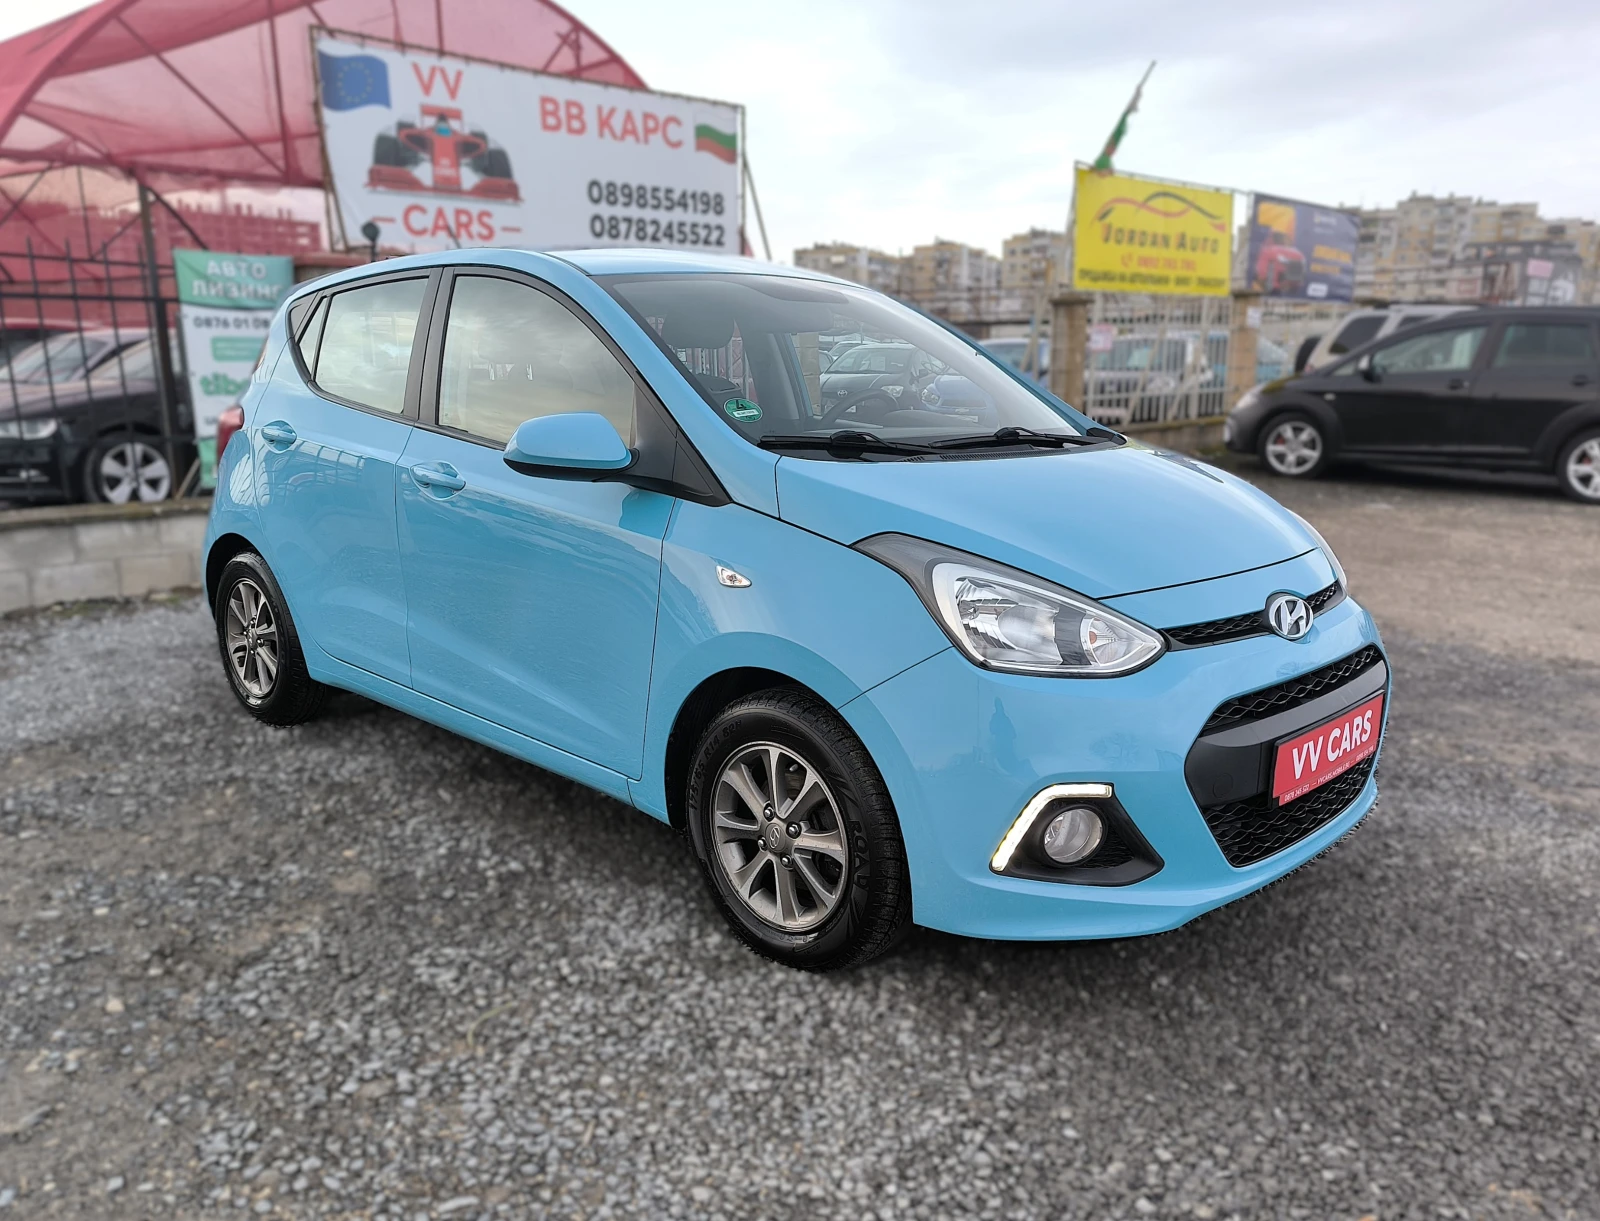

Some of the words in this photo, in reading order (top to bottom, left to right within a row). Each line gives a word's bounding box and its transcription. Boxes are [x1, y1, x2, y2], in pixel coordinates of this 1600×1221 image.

[411, 62, 464, 100] VV
[597, 105, 685, 149] КАРС
[587, 180, 726, 216] 0898554198
[403, 204, 496, 242] CARS
[590, 214, 726, 248] 0878245522
[206, 259, 267, 280] АВТО
[1292, 735, 1324, 780] VV
[1326, 709, 1373, 762] CARS
